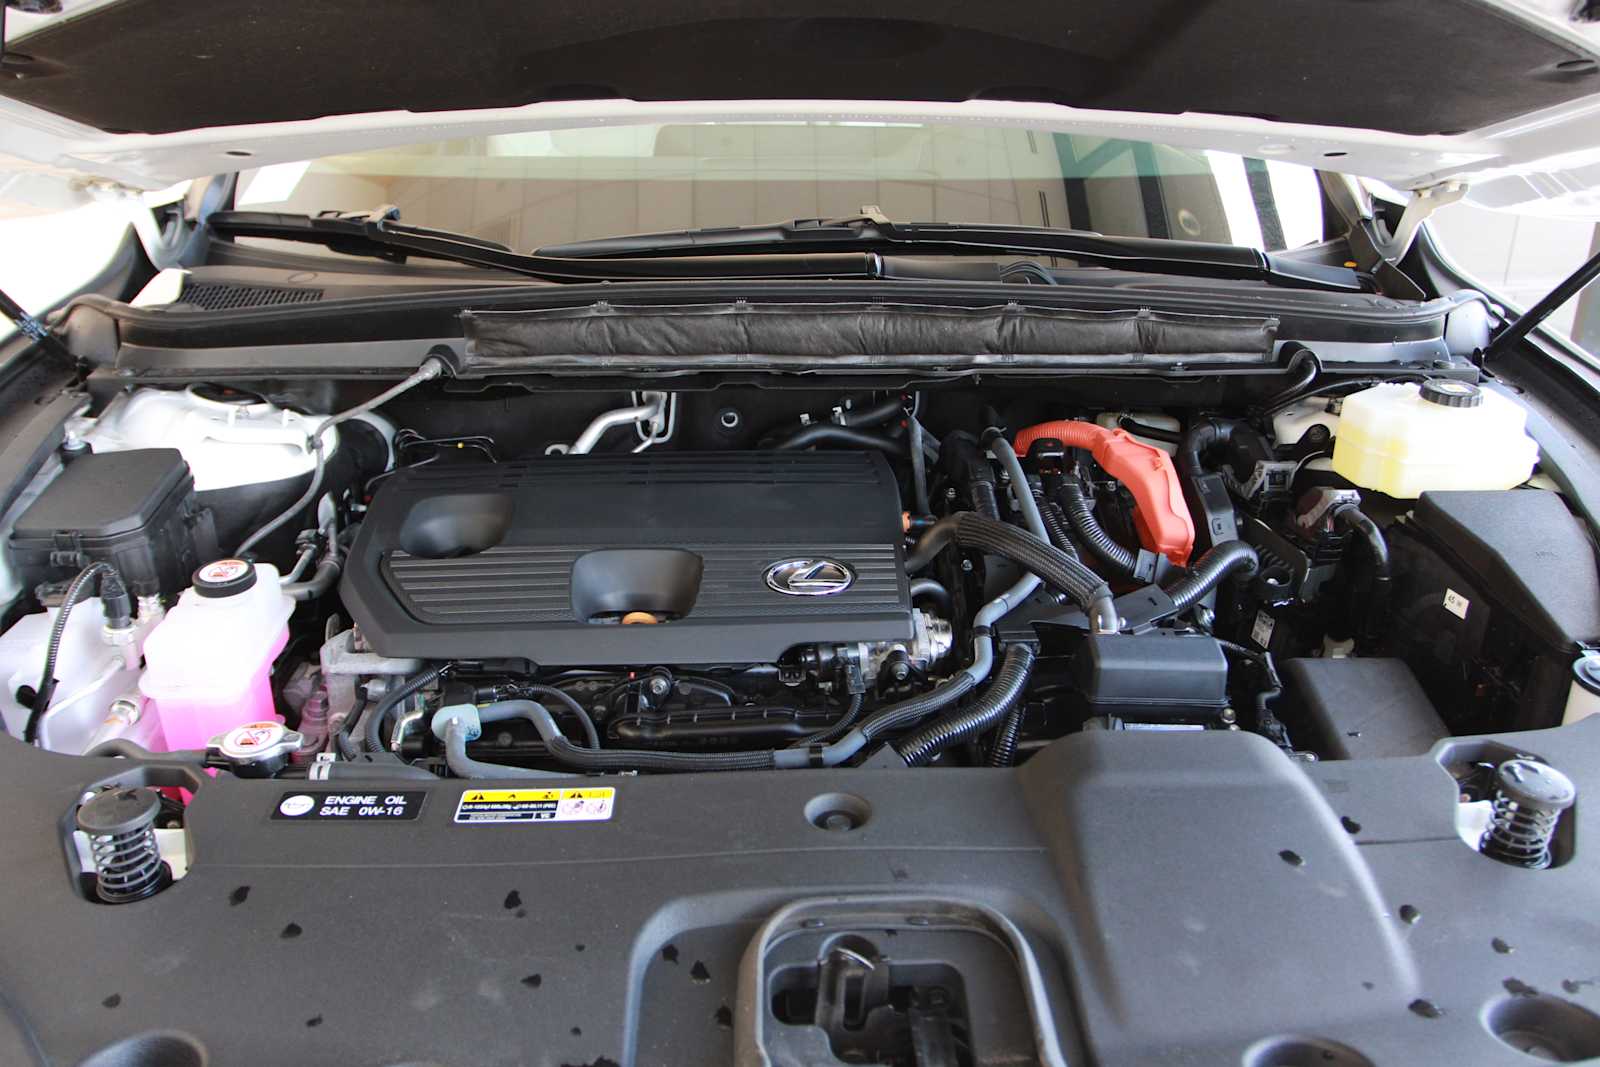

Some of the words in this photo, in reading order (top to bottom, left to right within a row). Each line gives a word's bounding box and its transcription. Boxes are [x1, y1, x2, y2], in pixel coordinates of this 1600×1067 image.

[324, 795, 378, 805] ENGINE
[384, 795, 408, 805] OIL
[319, 806, 351, 816] SAE
[358, 806, 404, 816] 0W-16
